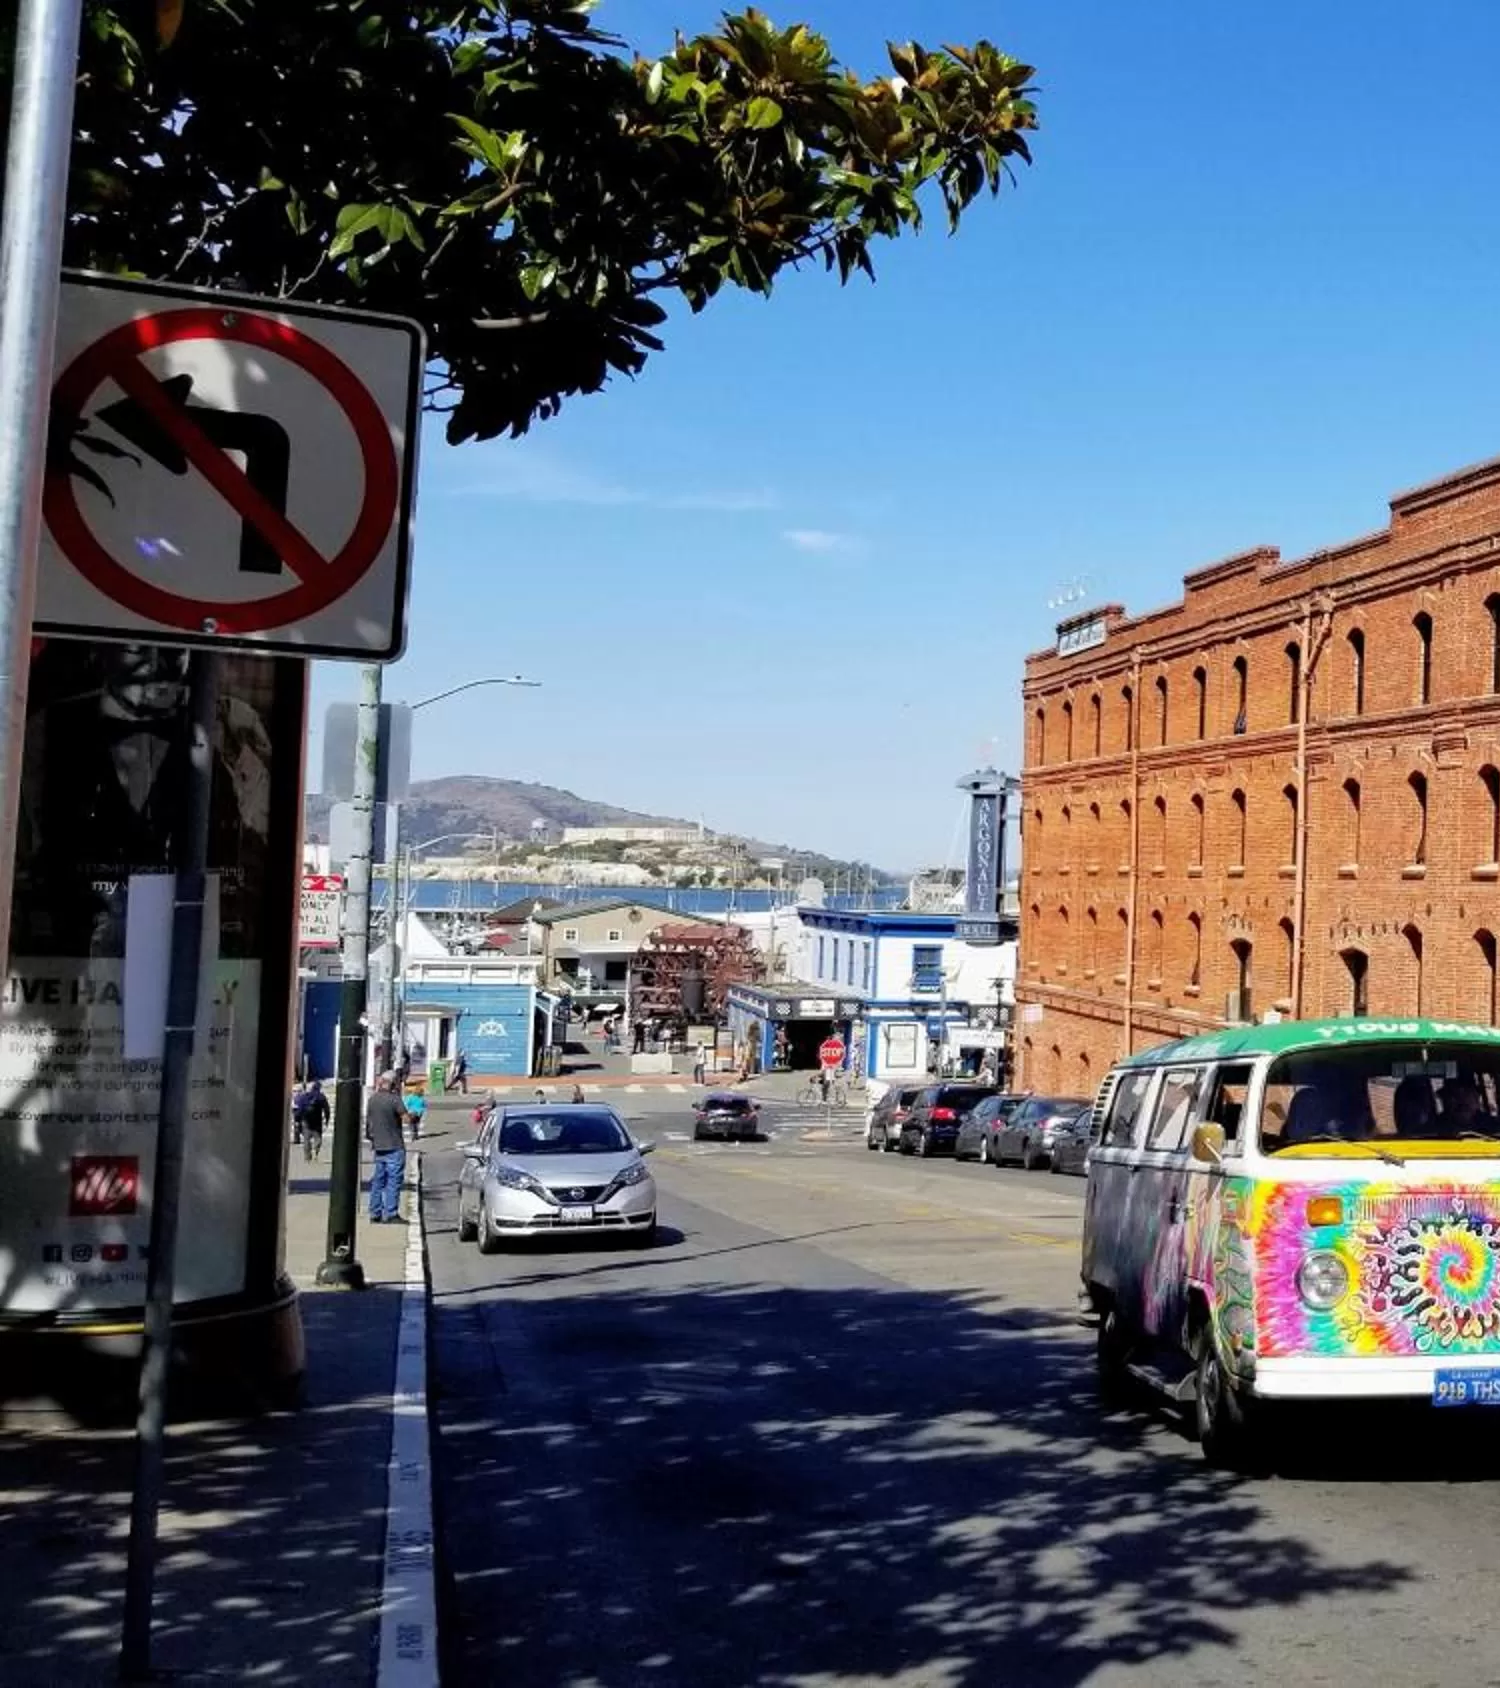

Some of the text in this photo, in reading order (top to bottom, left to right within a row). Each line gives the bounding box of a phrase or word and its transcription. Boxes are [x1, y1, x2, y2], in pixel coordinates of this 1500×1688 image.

[977, 799, 991, 912] ARGONAUT
[91, 880, 119, 895] my
[301, 901, 330, 911] ONLY
[4, 978, 60, 1005] IVE
[822, 1047, 842, 1057] STOP
